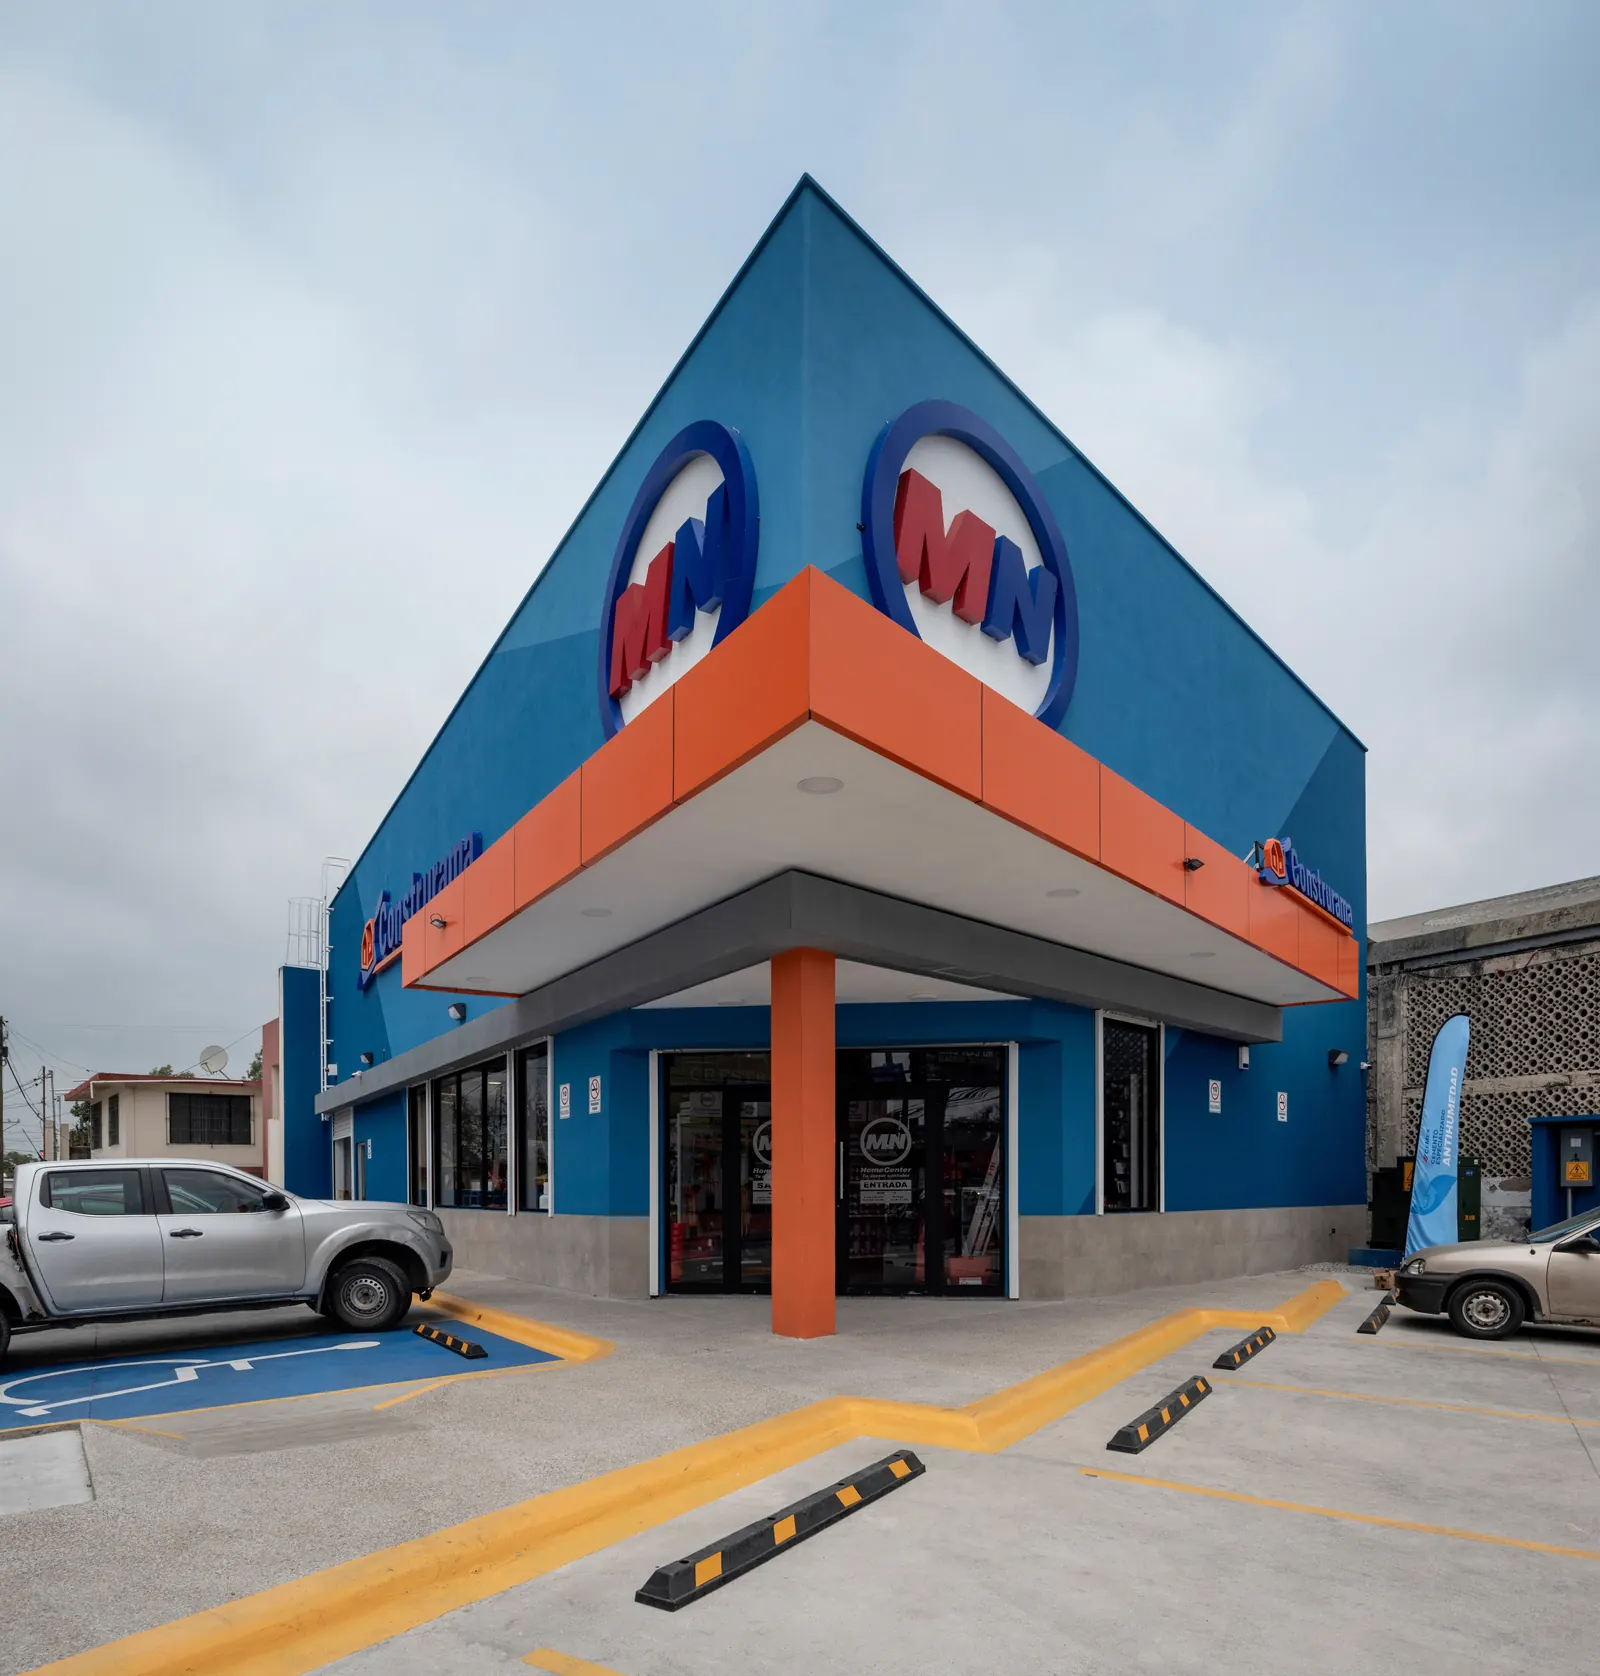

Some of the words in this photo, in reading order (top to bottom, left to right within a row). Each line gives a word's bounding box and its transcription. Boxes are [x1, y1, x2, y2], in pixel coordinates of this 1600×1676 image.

[609, 481, 730, 698] MN
[895, 468, 1057, 666] MN
[1291, 847, 1353, 924] Construrama
[866, 1134, 907, 1150] MN
[1430, 1129, 1439, 1165] CEMENTO
[1436, 1109, 1446, 1166] ESPECIALIZADO
[1442, 1066, 1459, 1167] ANTIHUMEDAD
